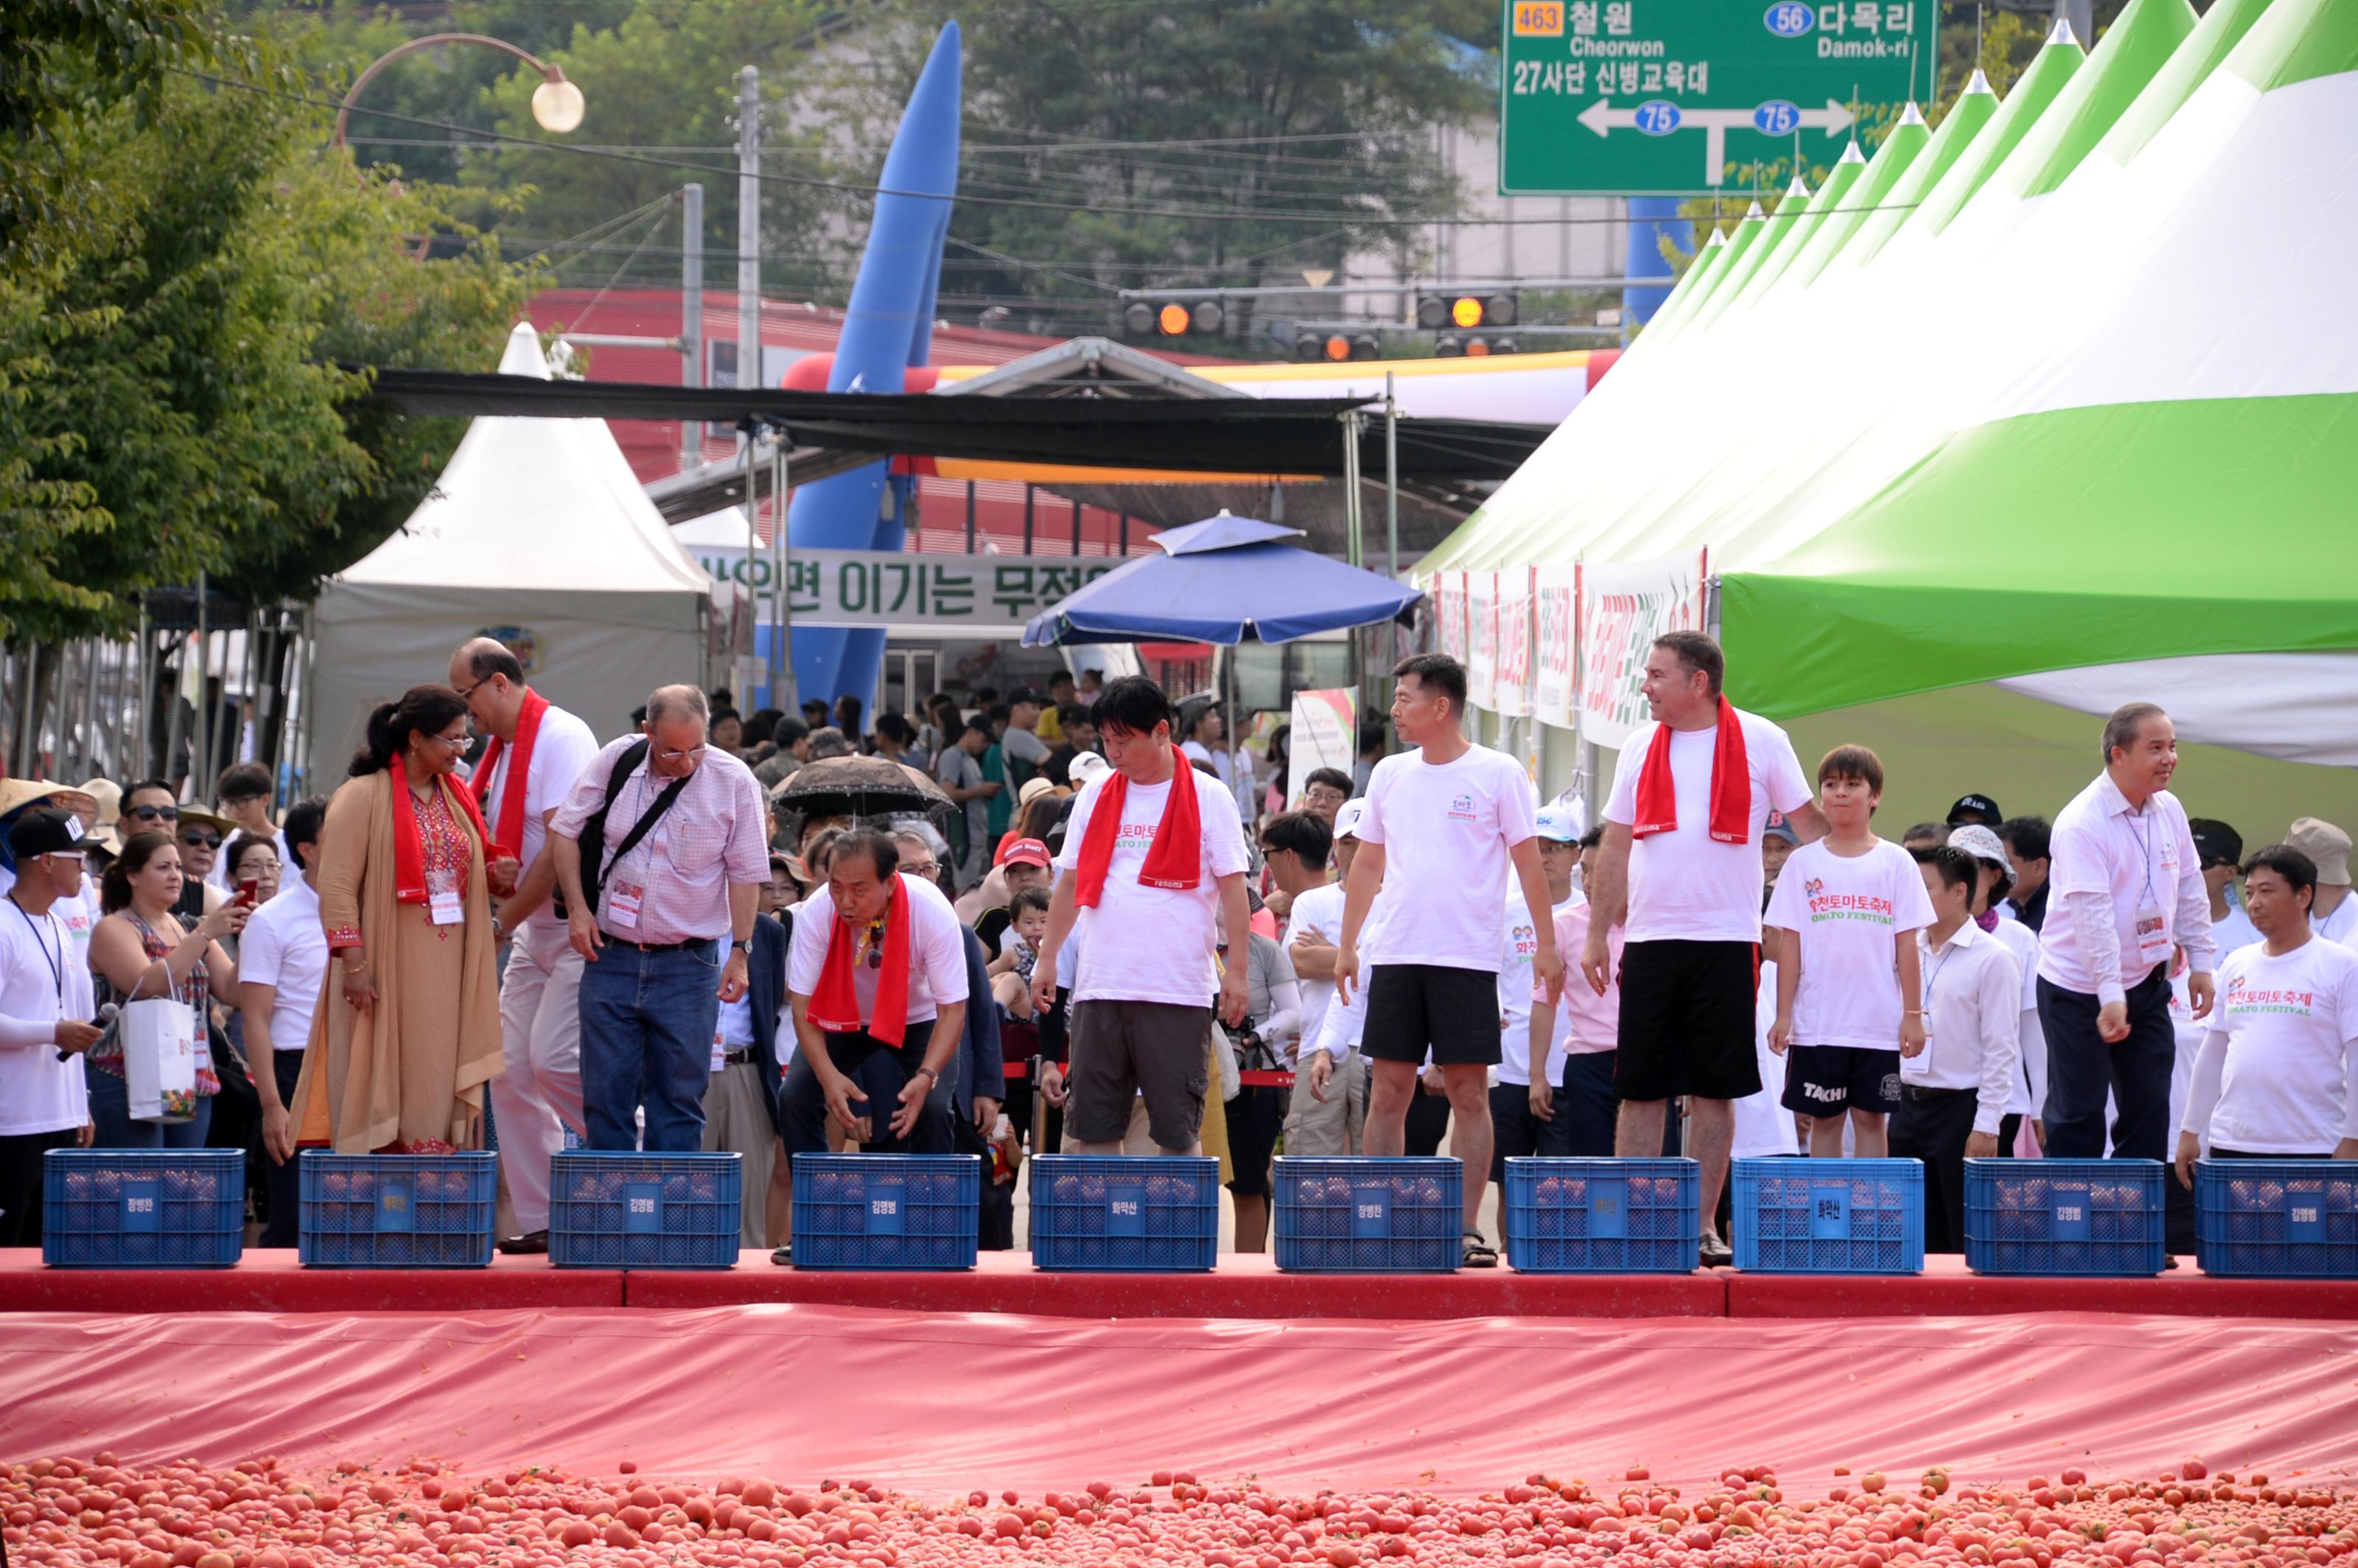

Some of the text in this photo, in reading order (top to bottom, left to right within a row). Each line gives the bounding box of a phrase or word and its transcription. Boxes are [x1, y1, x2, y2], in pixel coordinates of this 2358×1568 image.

[1519, 7, 1558, 29] 463
[1570, 1, 1632, 35] 철원
[1777, 7, 1805, 32] 56
[1819, 1, 1914, 35] 다목리
[1570, 36, 1665, 57] Cheorwon
[1817, 37, 1909, 57] Damok-ri
[1514, 60, 1708, 95] 27사단 신병교육대
[1645, 105, 1672, 130] 75
[1763, 106, 1791, 130] 75
[839, 561, 974, 615] 이기는
[993, 565, 1111, 617] 무적
[1354, 810, 1361, 822] 7
[1155, 881, 1183, 889] renoma
[2261, 1007, 2311, 1016] FESTIVAL
[1112, 1201, 1137, 1215] 화악산
[1819, 1200, 1841, 1219] 화악산
